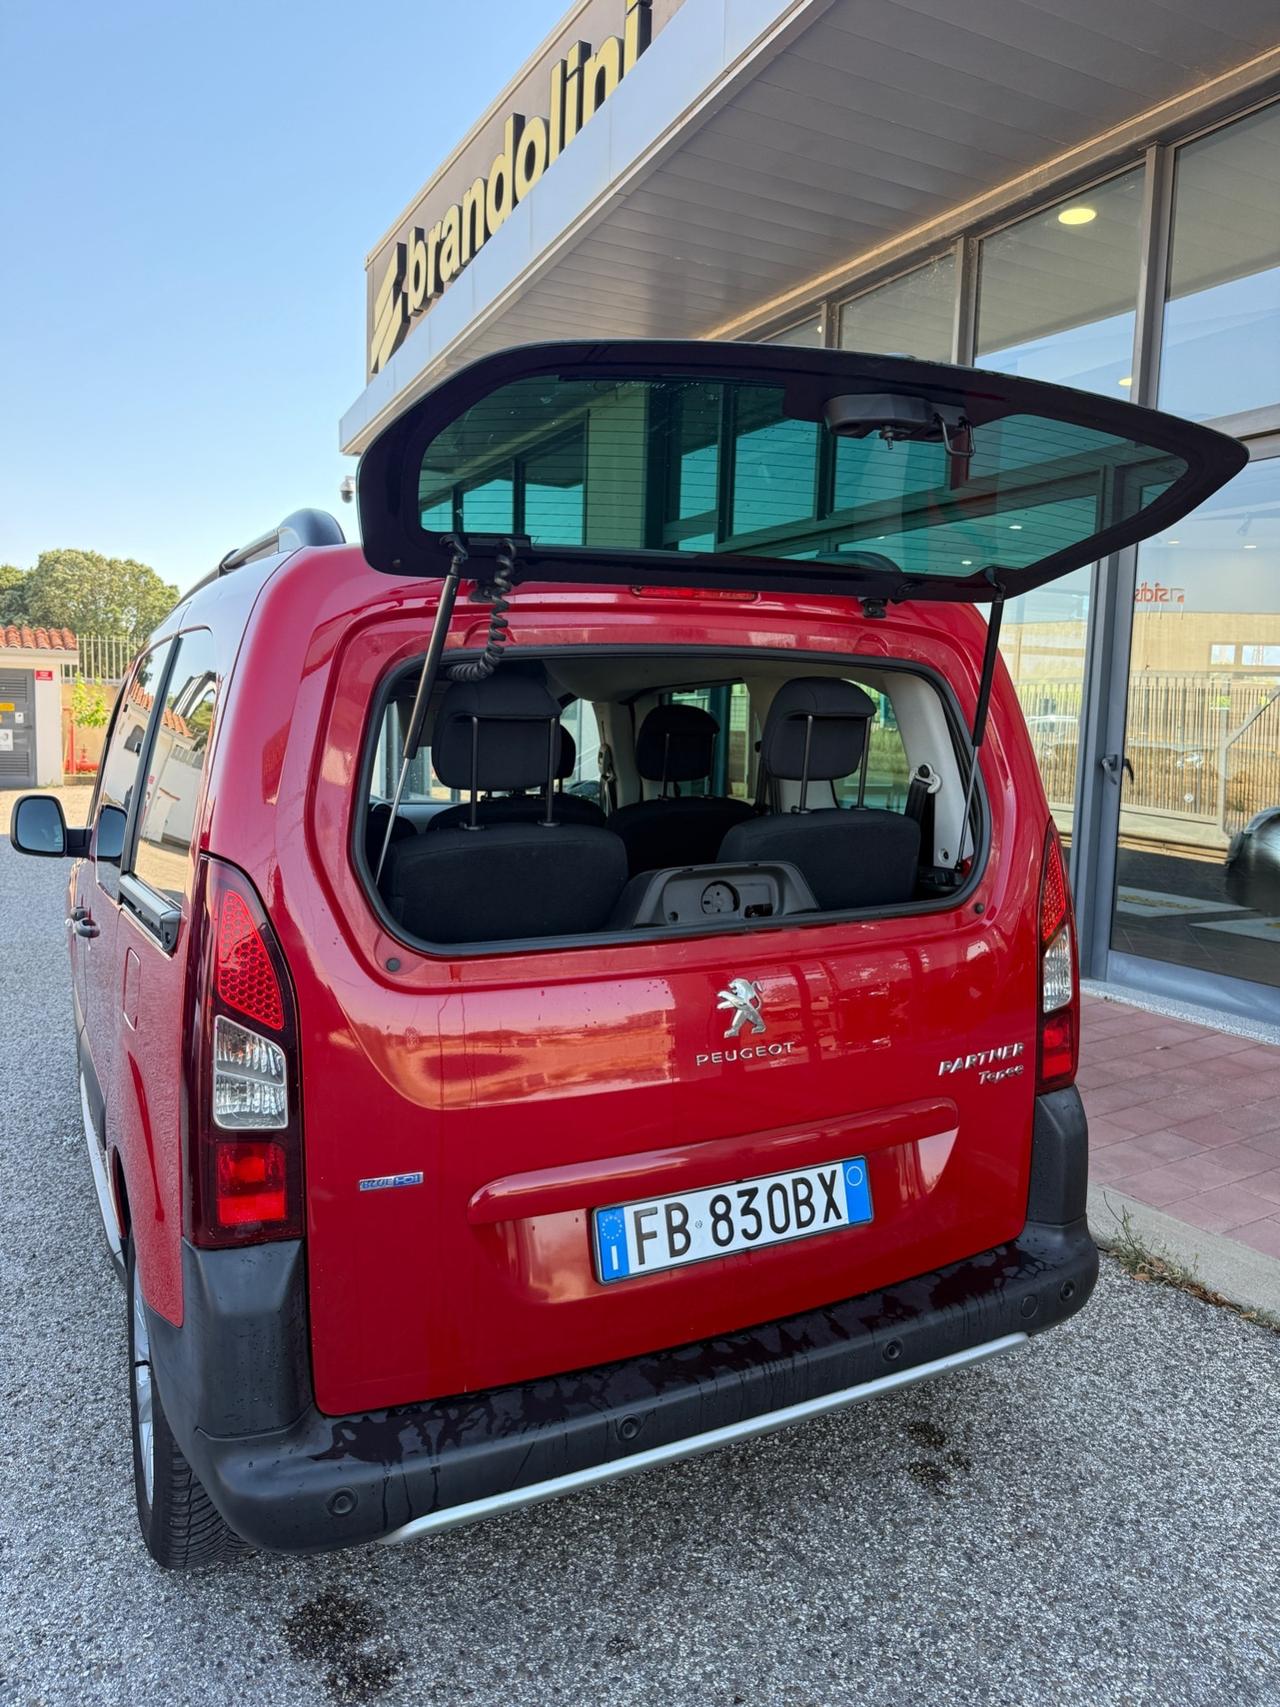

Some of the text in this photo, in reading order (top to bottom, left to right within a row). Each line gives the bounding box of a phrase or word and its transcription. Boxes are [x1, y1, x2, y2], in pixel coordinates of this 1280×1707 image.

[405, 0, 652, 317] brandolini
[696, 1041, 795, 1067] PEUGEOT
[938, 1042, 1025, 1076] PARTNER
[978, 1064, 1024, 1085] Tepee
[633, 1202, 692, 1266] FB
[708, 1169, 843, 1248] 830BX
